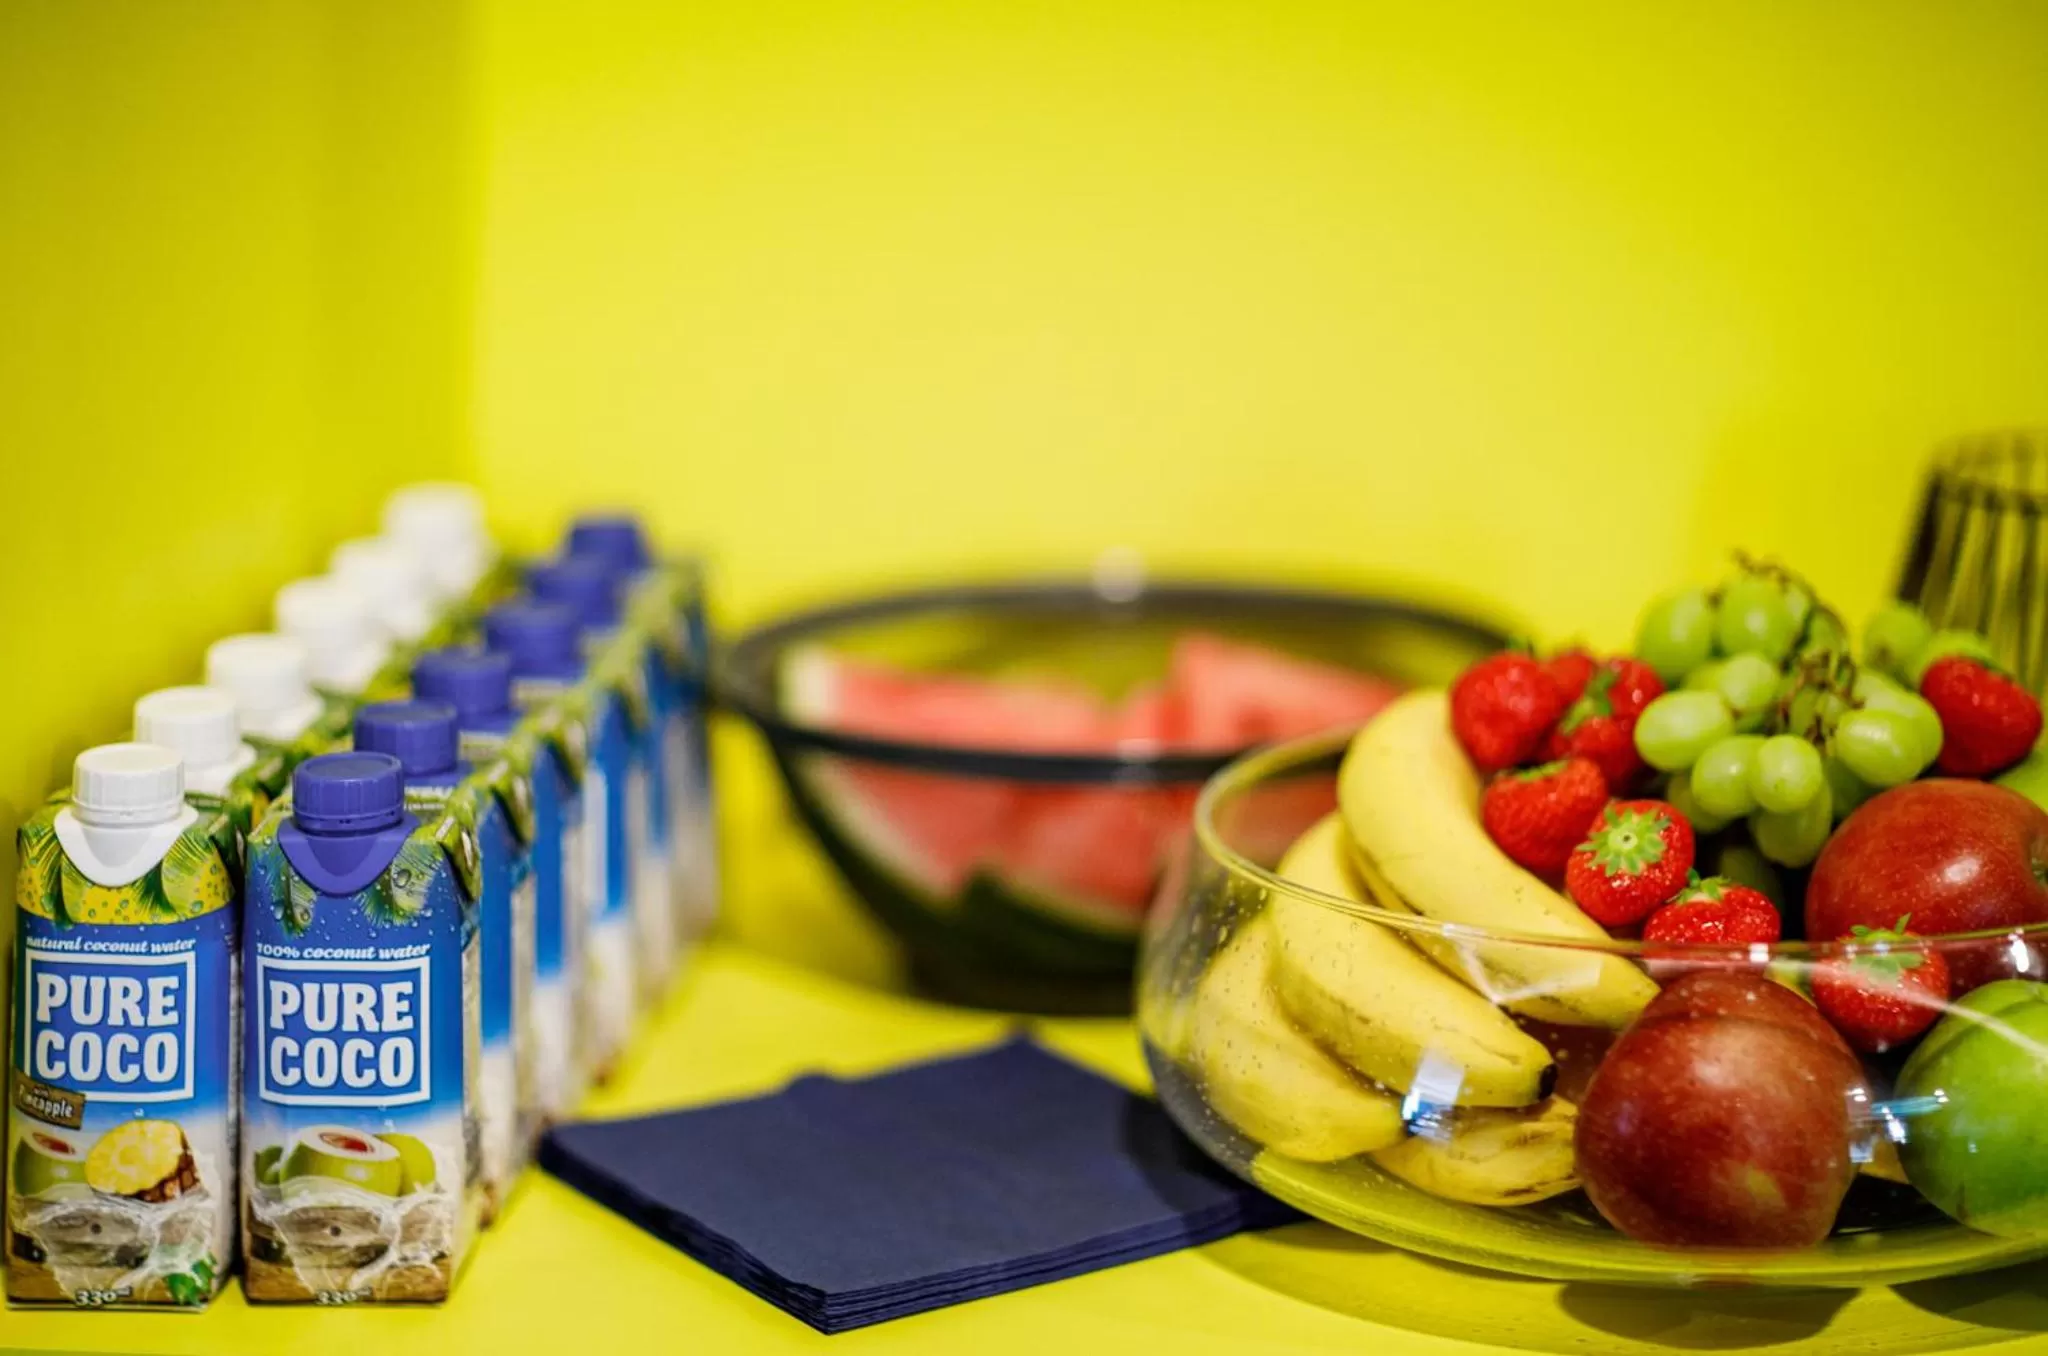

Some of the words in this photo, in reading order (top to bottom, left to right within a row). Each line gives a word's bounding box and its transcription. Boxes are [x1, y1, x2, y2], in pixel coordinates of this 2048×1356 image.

[26, 936, 82, 951] natural
[84, 939, 149, 953] coconut
[151, 939, 197, 953] water
[256, 943, 300, 958] 100%
[303, 946, 376, 959] coconut
[378, 944, 431, 959] water
[36, 972, 180, 1027] PURE
[269, 980, 415, 1032] PURE
[36, 1029, 180, 1083] COCO
[270, 1036, 415, 1088] COCO
